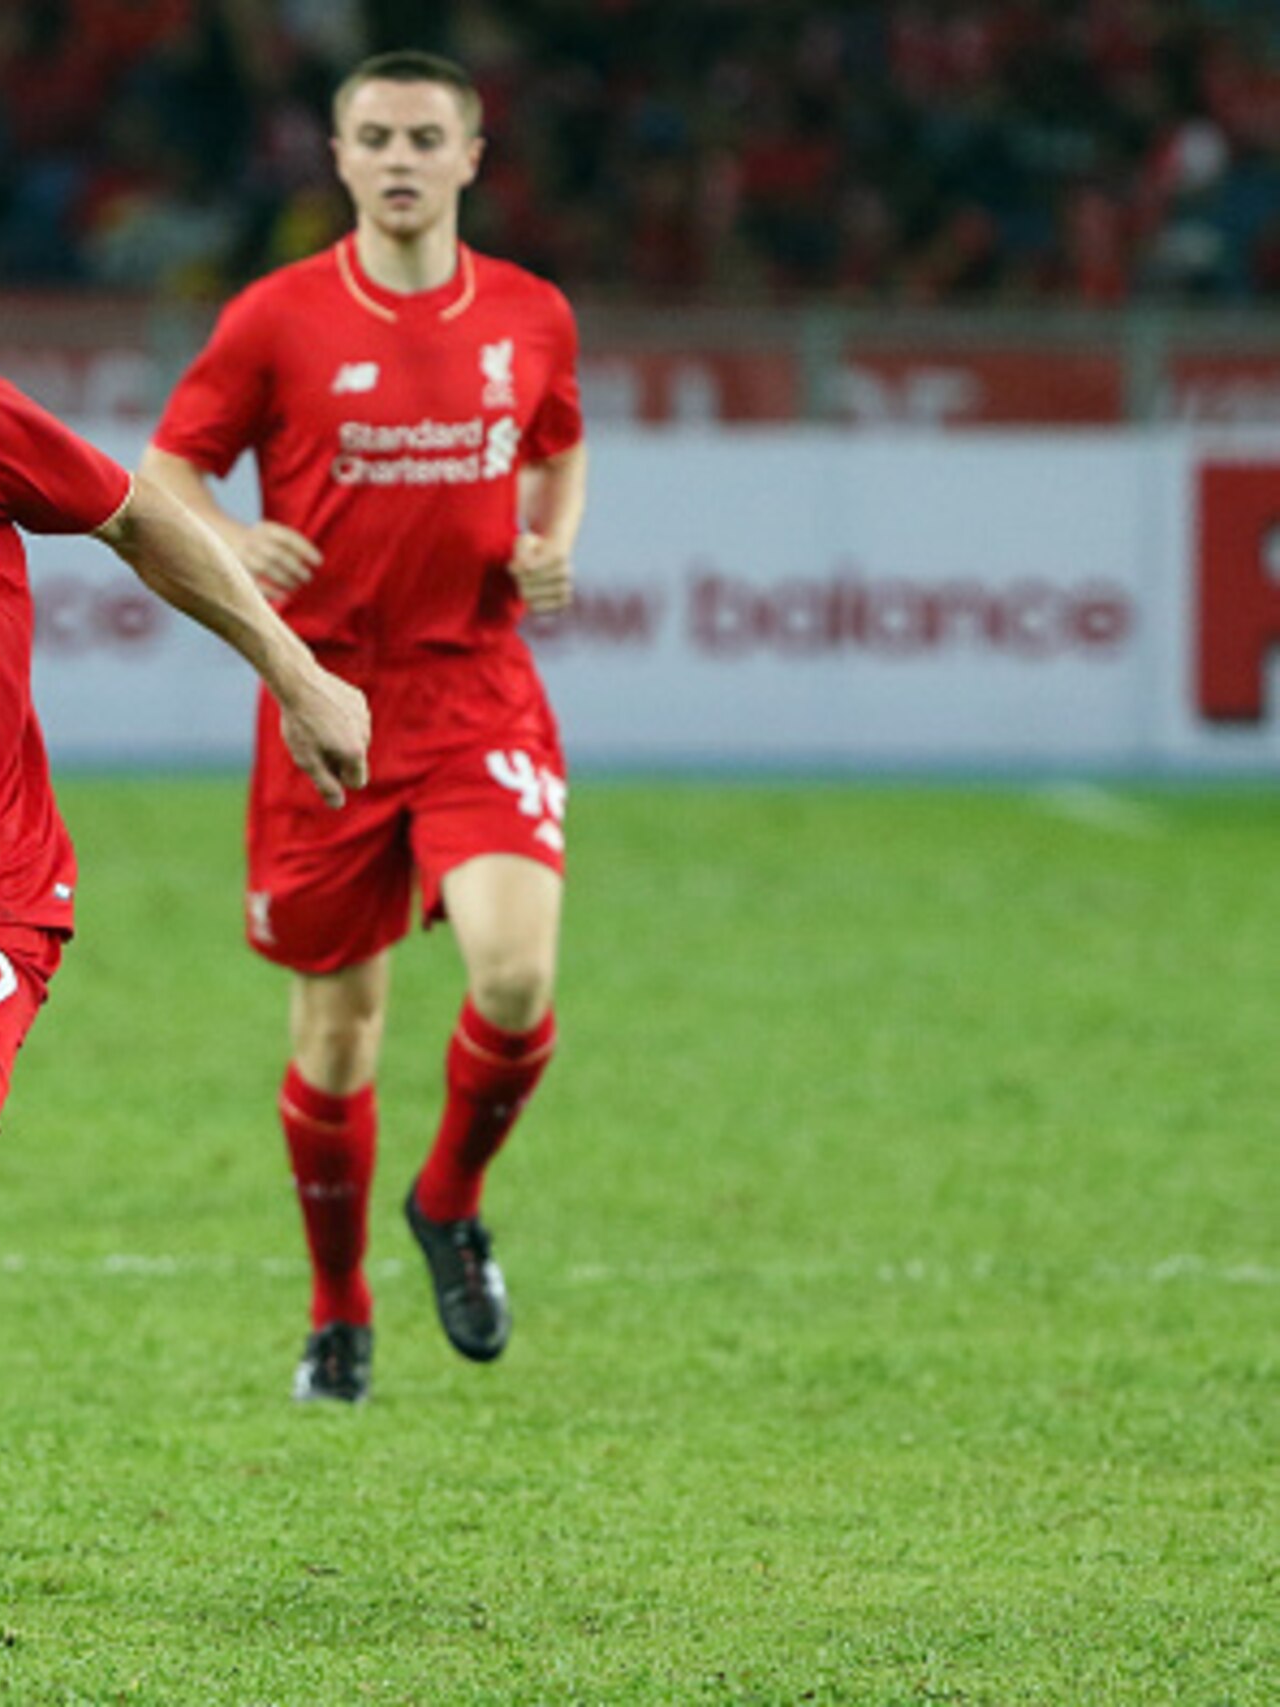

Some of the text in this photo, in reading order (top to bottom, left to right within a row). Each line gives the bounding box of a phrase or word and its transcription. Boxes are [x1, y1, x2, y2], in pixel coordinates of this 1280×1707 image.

[339, 418, 483, 452] Standard
[331, 453, 480, 487] Chartered
[685, 558, 1132, 660] balance
